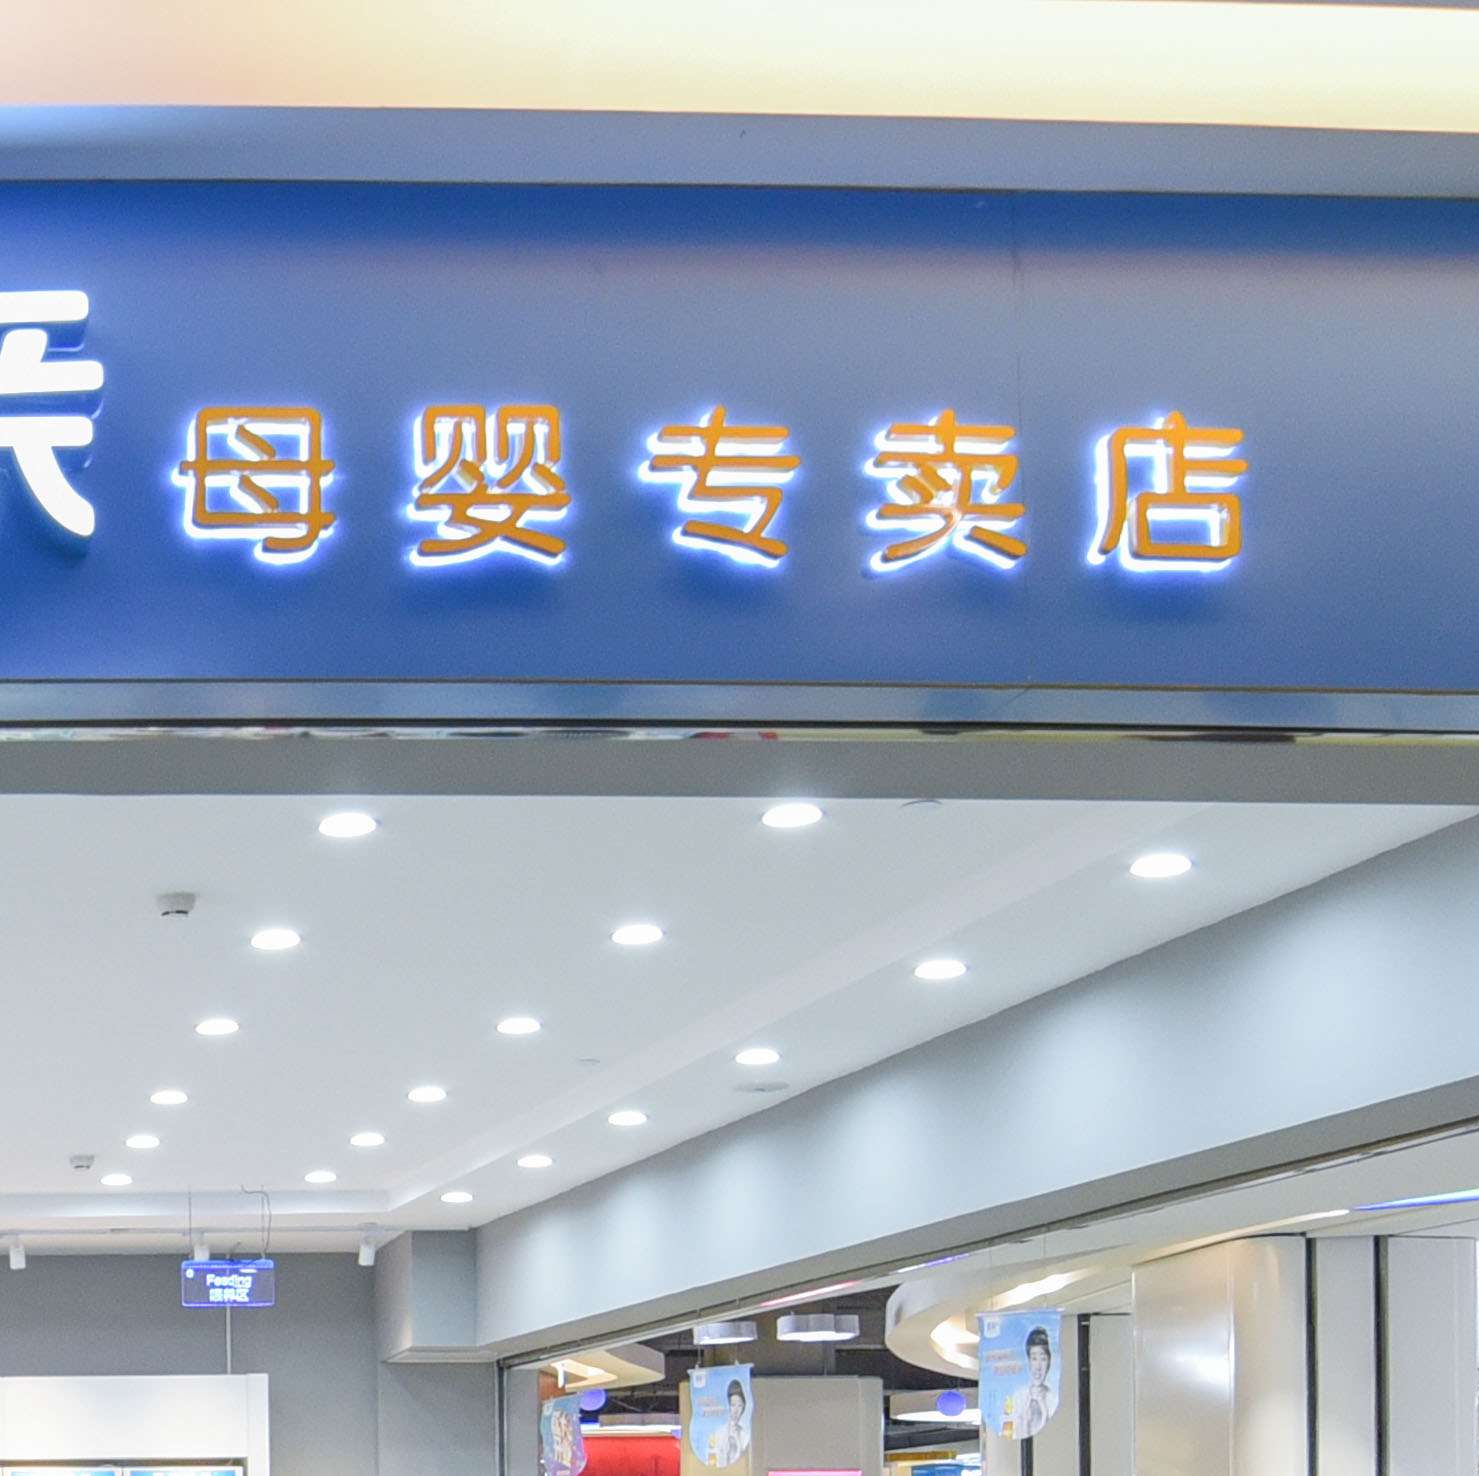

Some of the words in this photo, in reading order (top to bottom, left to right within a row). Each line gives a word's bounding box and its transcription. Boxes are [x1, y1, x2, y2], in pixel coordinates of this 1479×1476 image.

[178, 403, 1250, 562] 母婴专卖店
